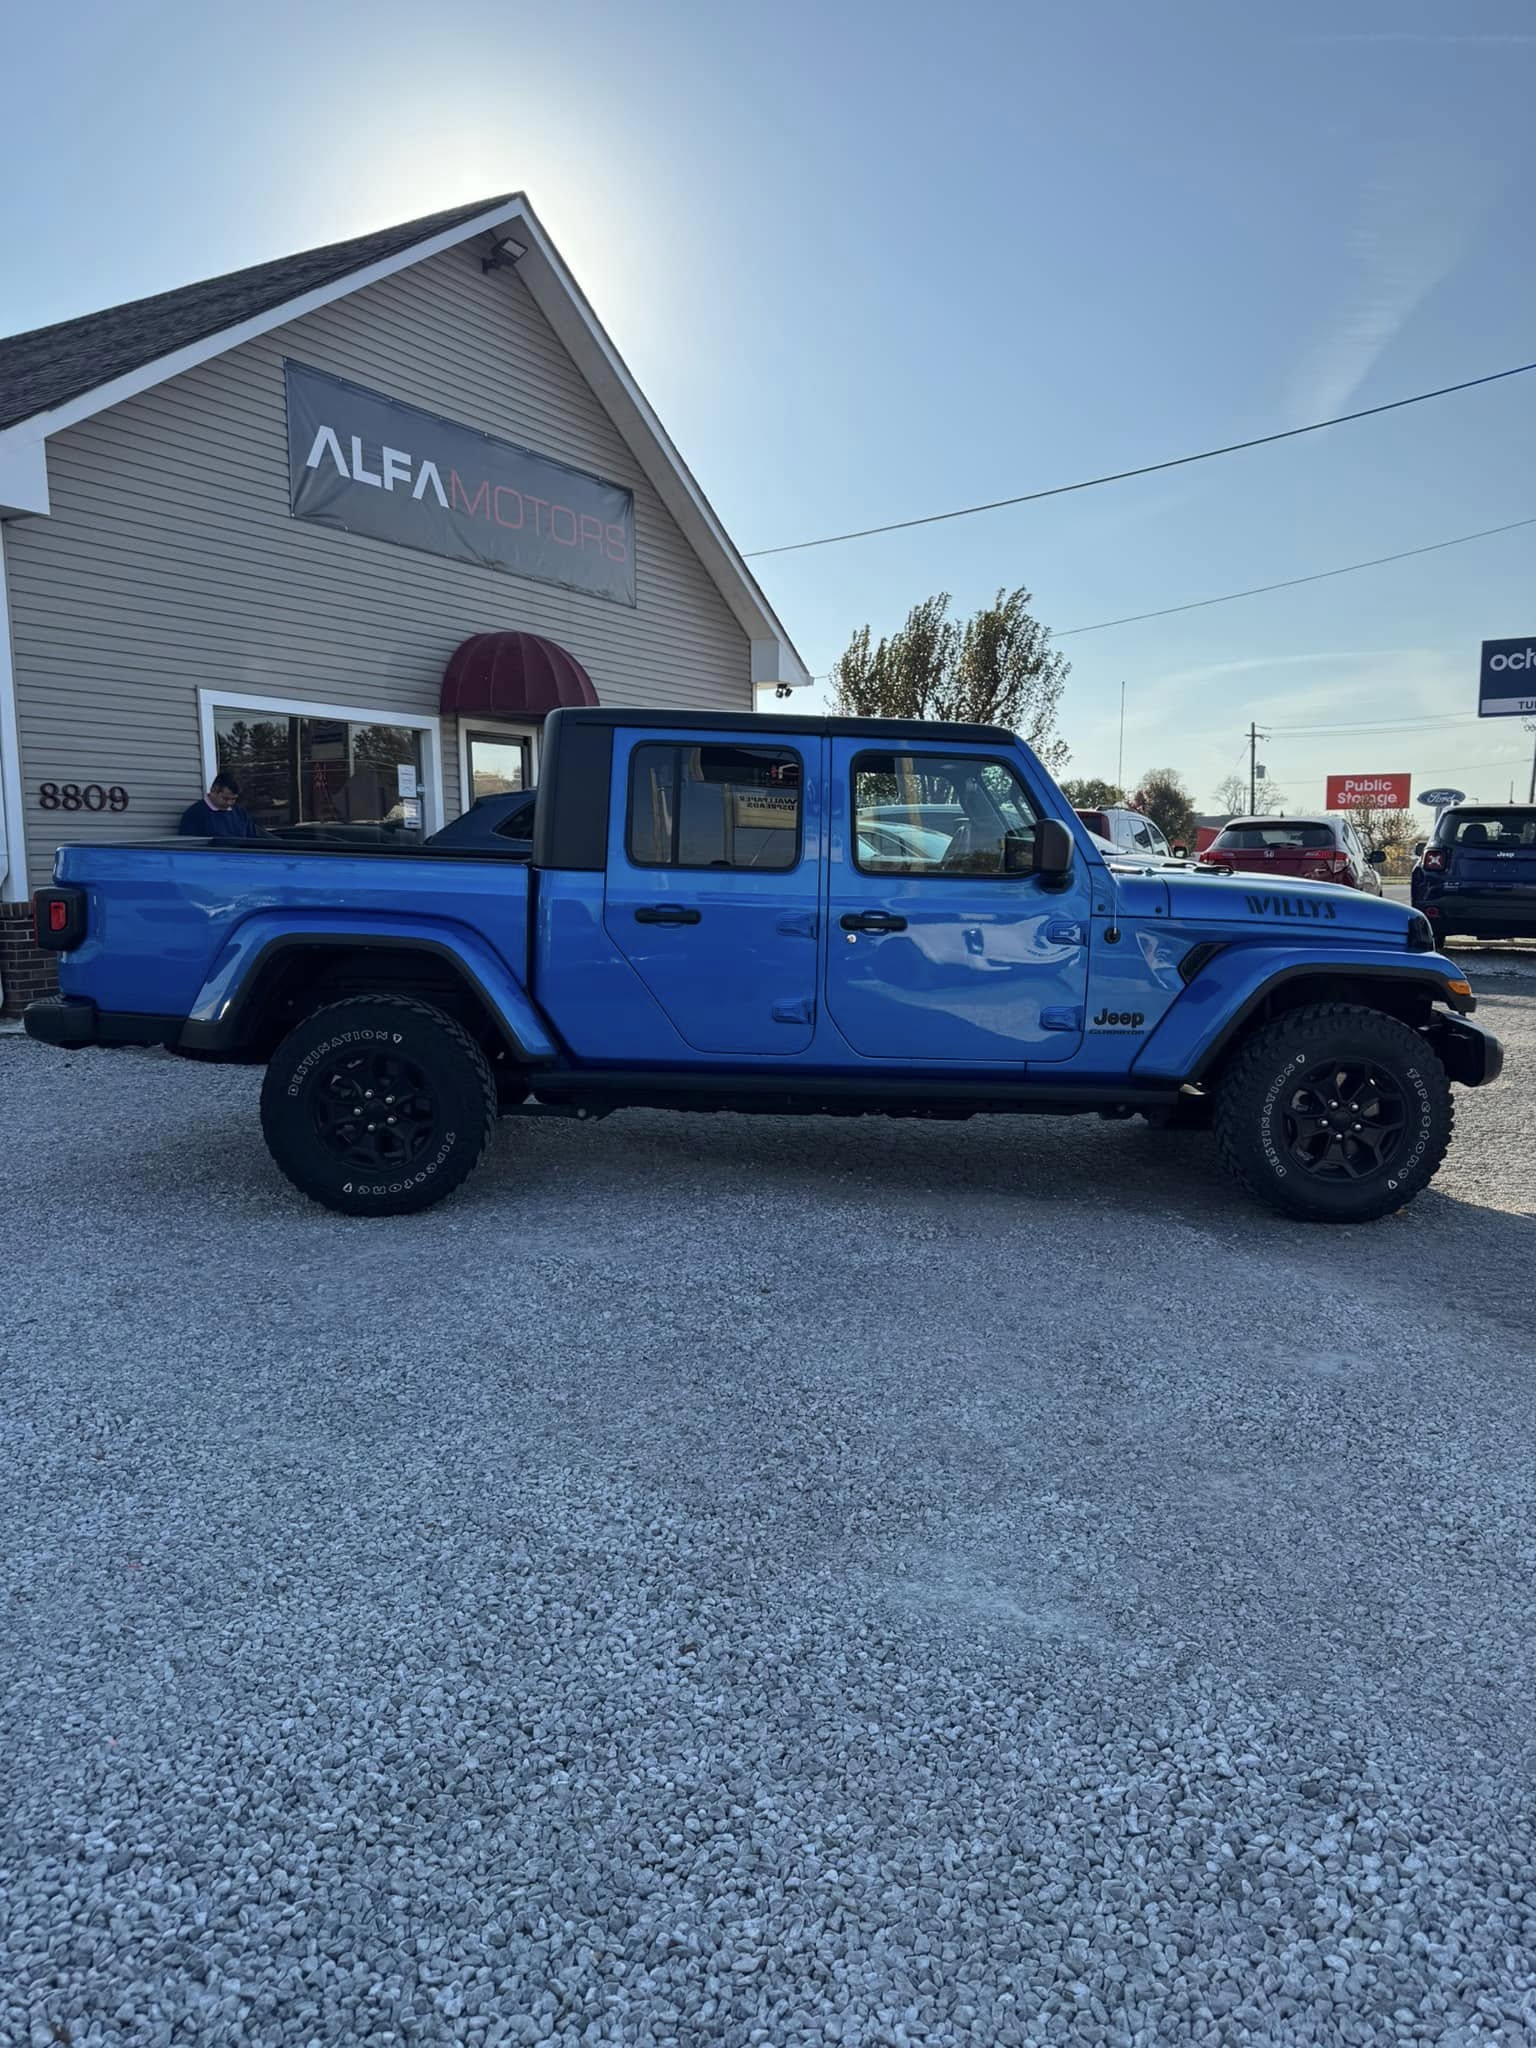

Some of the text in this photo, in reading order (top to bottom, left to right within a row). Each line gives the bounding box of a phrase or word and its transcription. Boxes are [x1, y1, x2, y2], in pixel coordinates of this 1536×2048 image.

[306, 425, 626, 563] ALFA MOTORS
[40, 782, 129, 812] 8809
[1345, 779, 1393, 792] Public
[1427, 791, 1457, 803] Ford
[1244, 895, 1336, 919] WILLYS
[1094, 1008, 1145, 1028] Jeep
[288, 1029, 389, 1097] DESTINATION
[1260, 1063, 1295, 1177] DESTINATION
